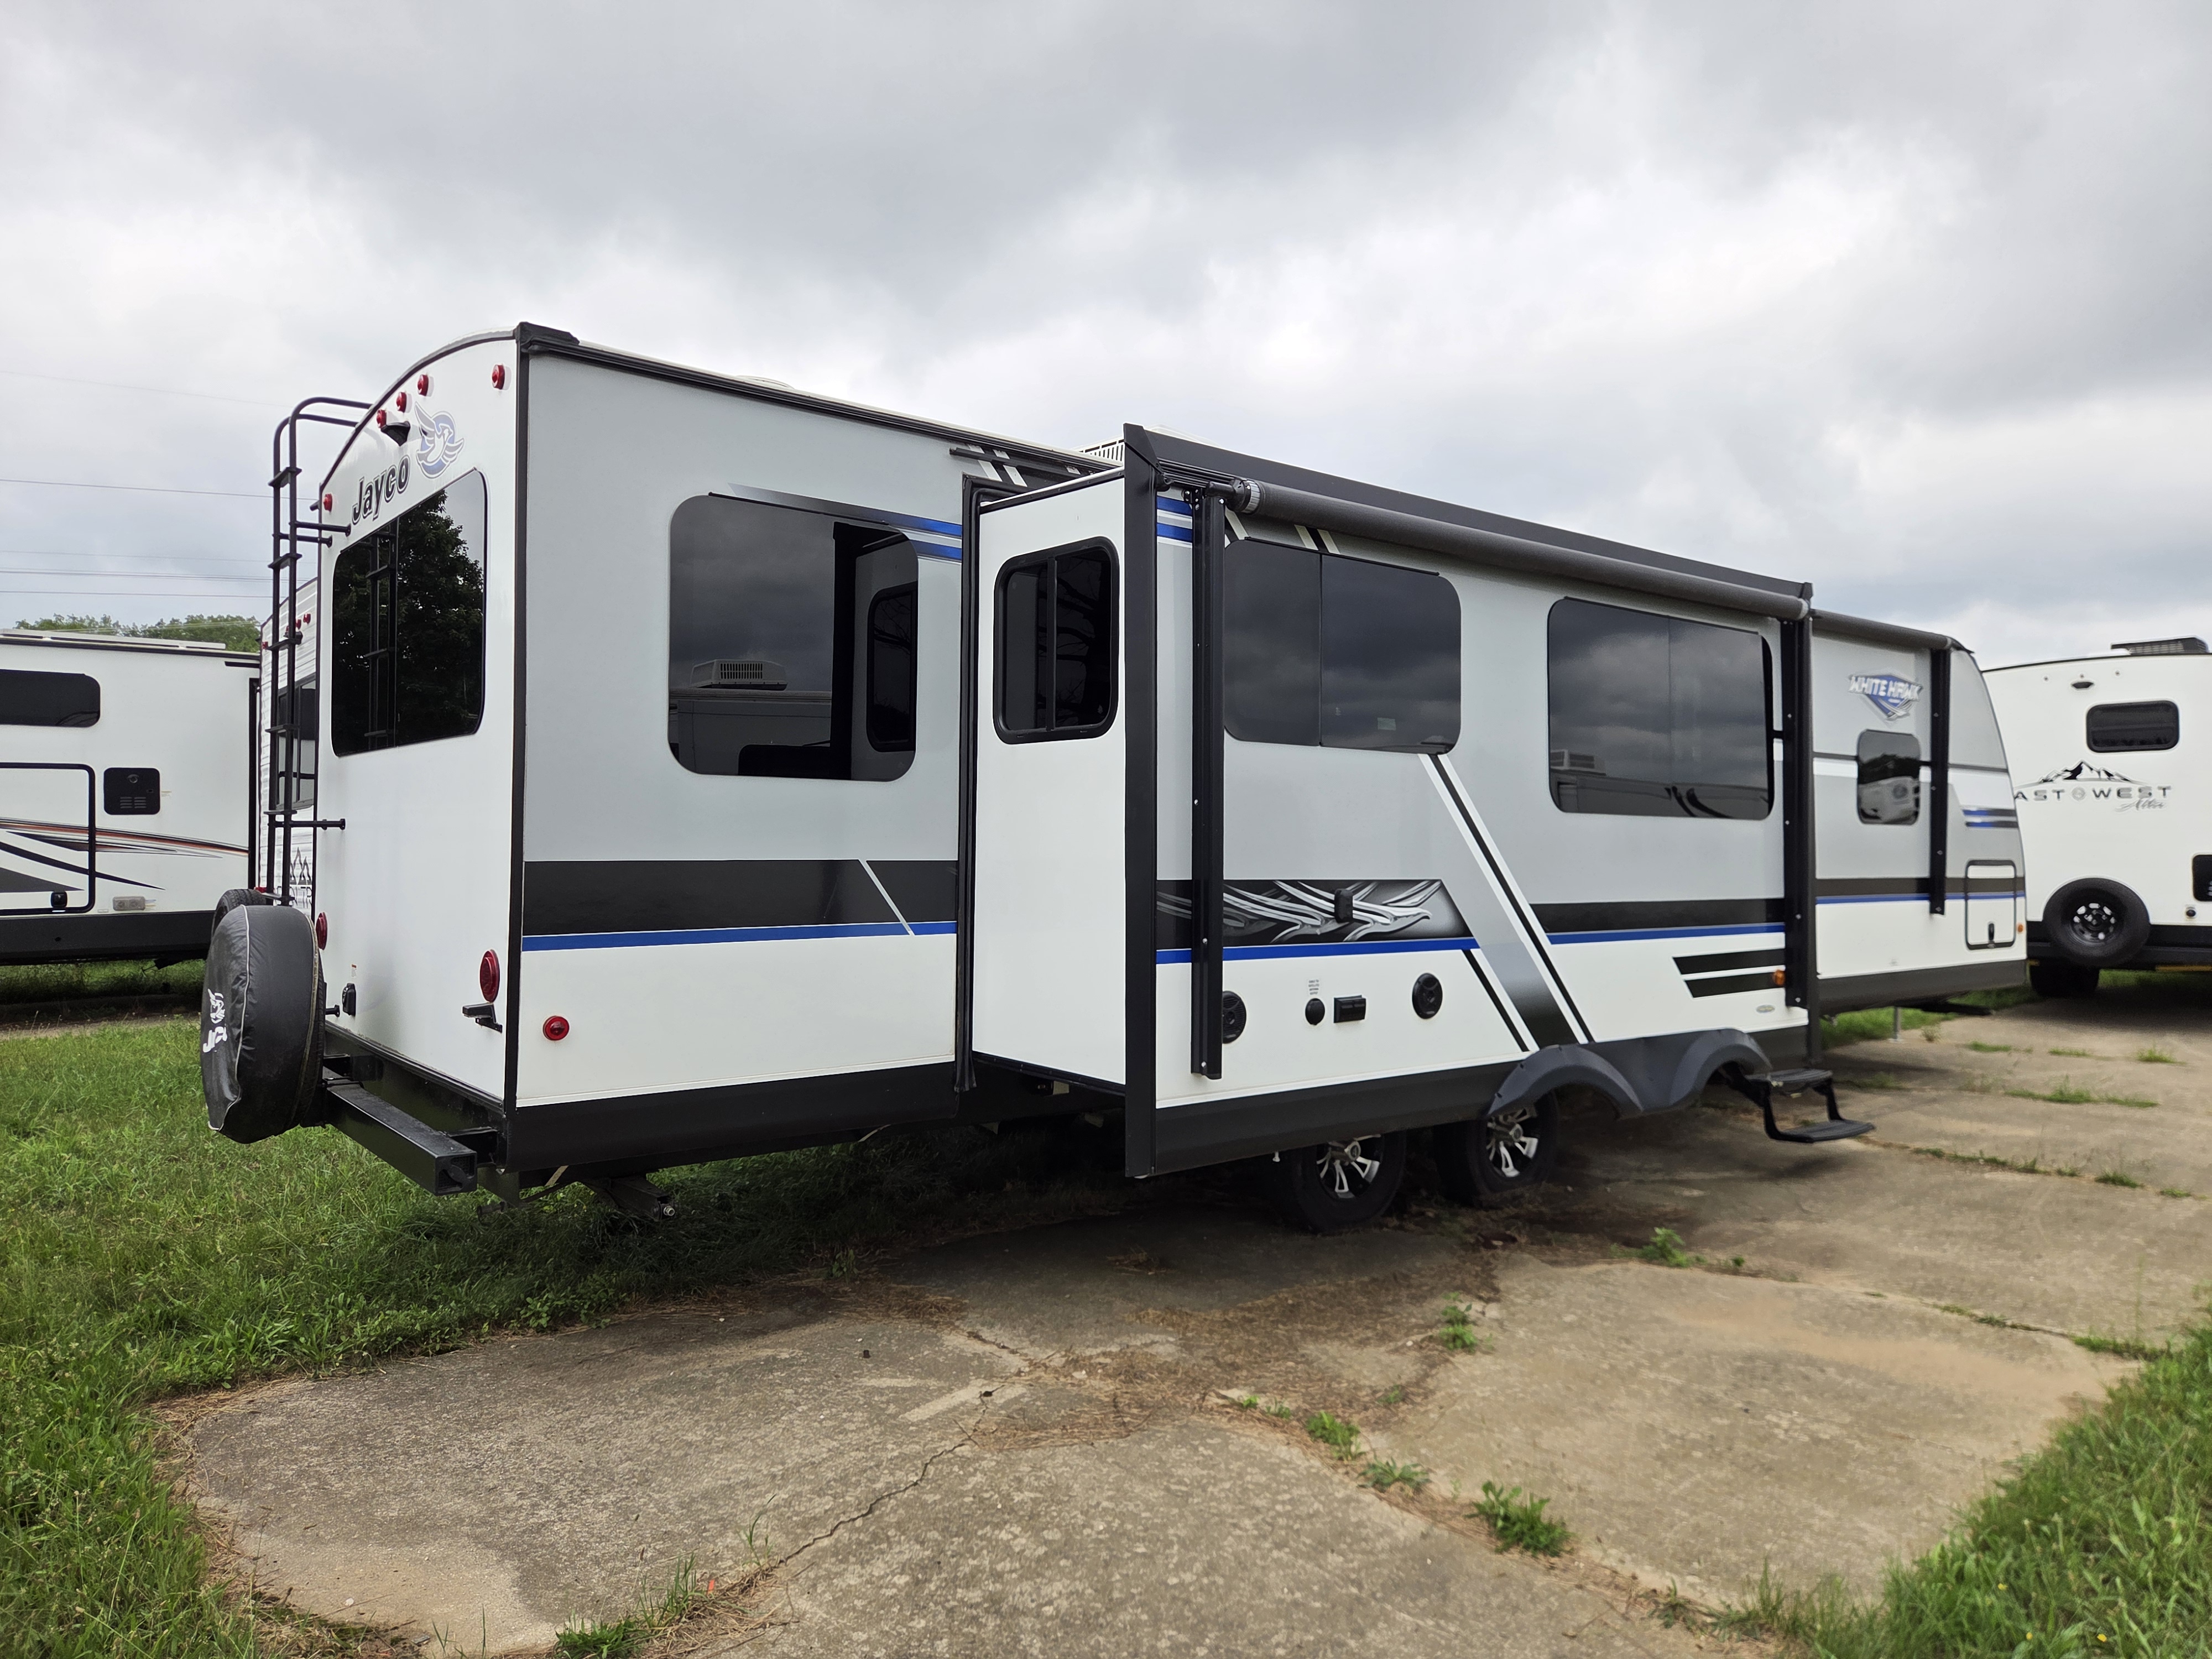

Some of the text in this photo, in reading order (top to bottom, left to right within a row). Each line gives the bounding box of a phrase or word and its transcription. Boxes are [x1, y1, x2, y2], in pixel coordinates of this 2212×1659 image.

[352, 455, 410, 525] Jayco
[1849, 676, 1887, 696] WHITE
[2014, 785, 2171, 801] AST WEST
